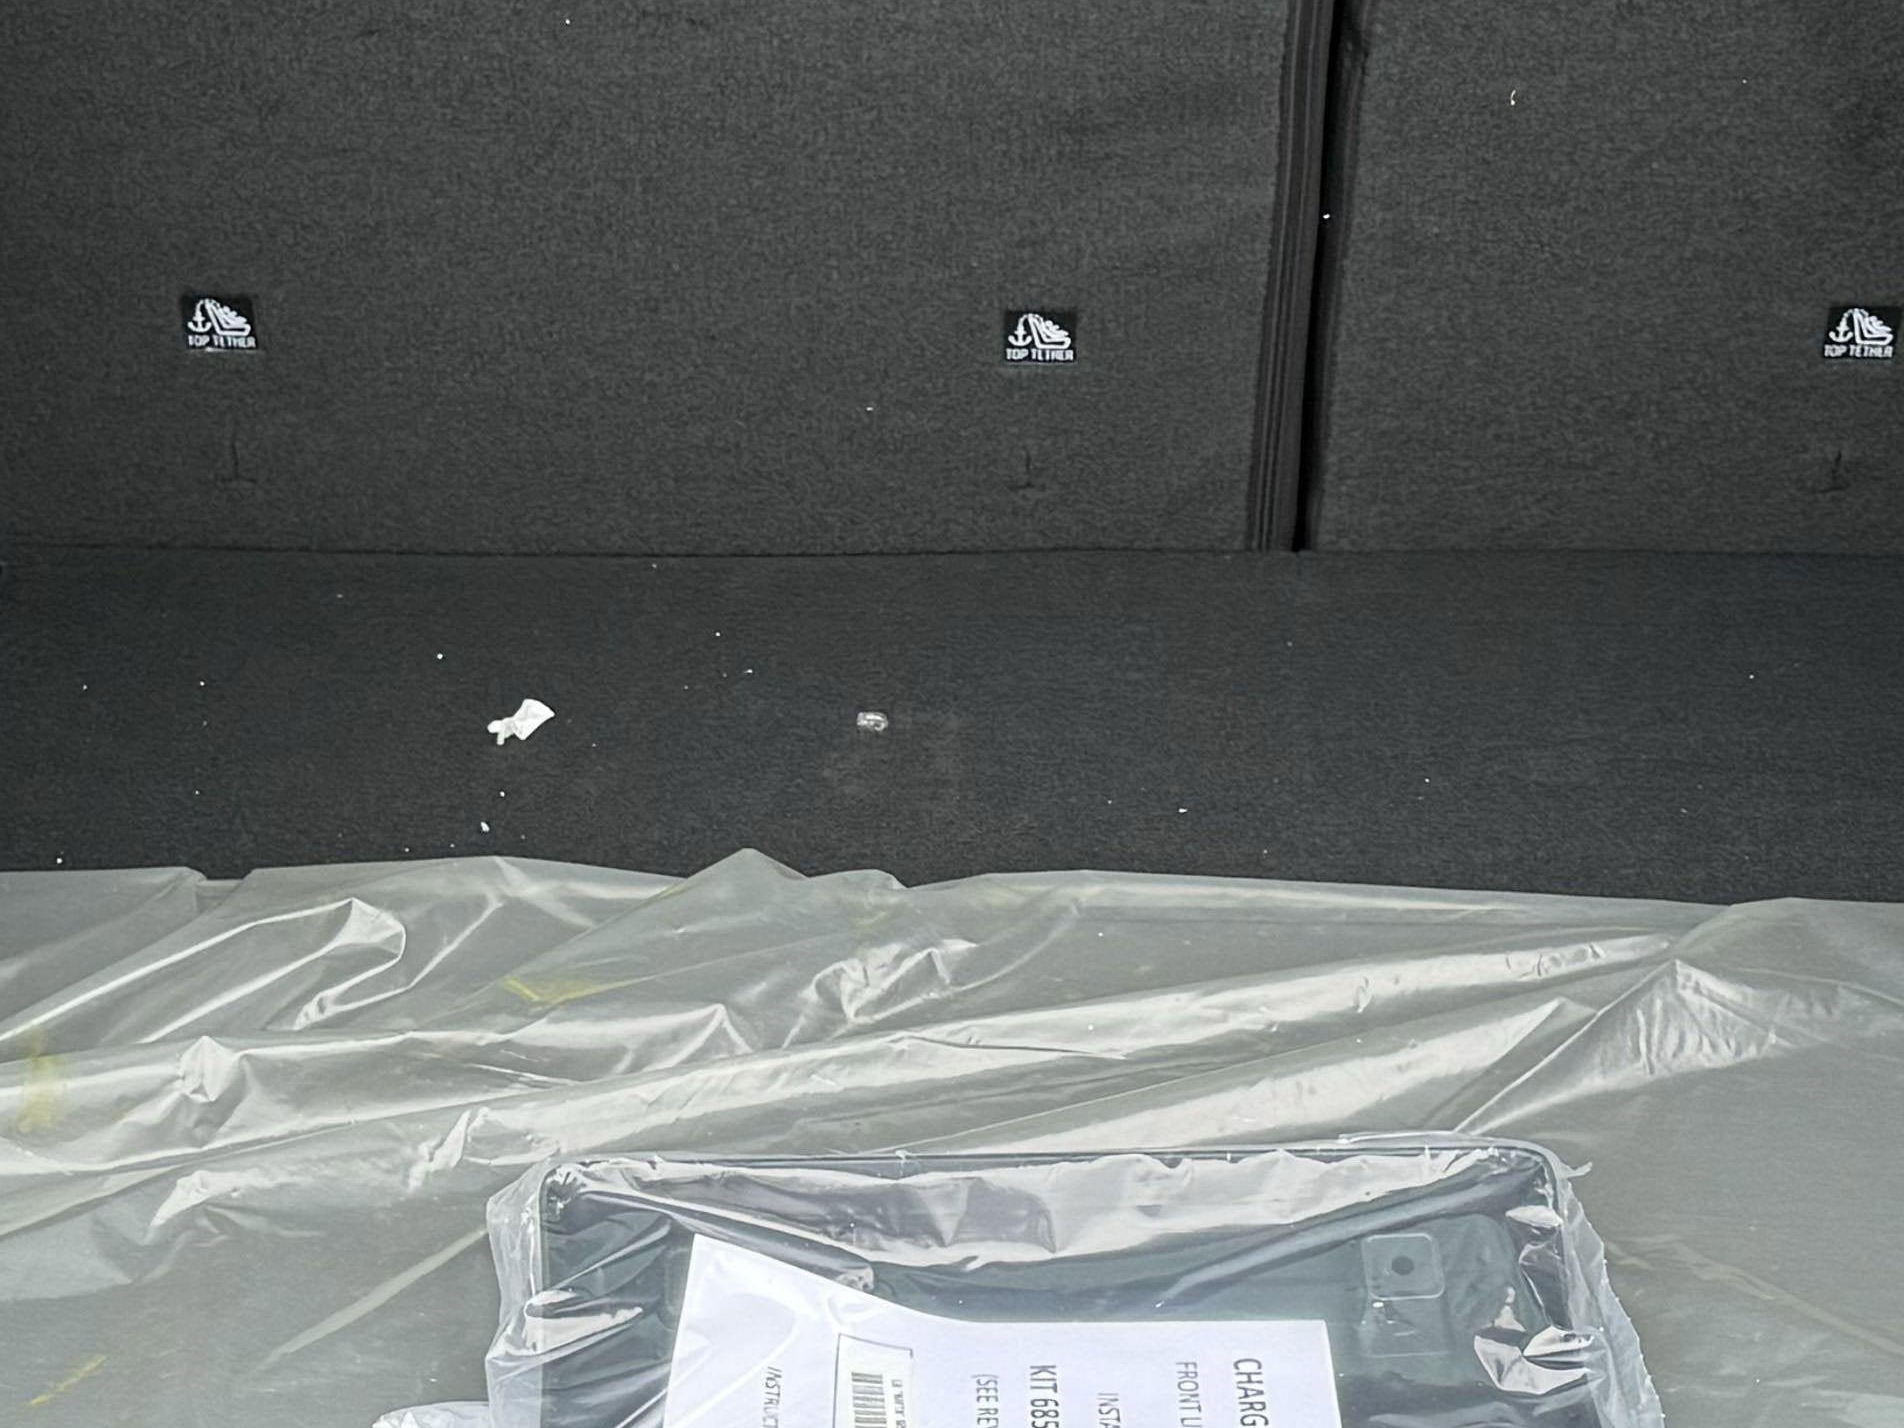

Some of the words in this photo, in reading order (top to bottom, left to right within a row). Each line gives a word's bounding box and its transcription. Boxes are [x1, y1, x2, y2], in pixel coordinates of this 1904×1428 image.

[188, 334, 210, 347] TOP
[212, 334, 256, 348] TETHER
[1824, 344, 1847, 357] TOP
[1849, 345, 1893, 358] TETHER
[1006, 347, 1029, 360] TOP
[1031, 348, 1074, 361] TETHER
[971, 1374, 1000, 1403] (SEE
[1029, 1364, 1058, 1394] KIT
[1175, 1360, 1202, 1414] FRONT
